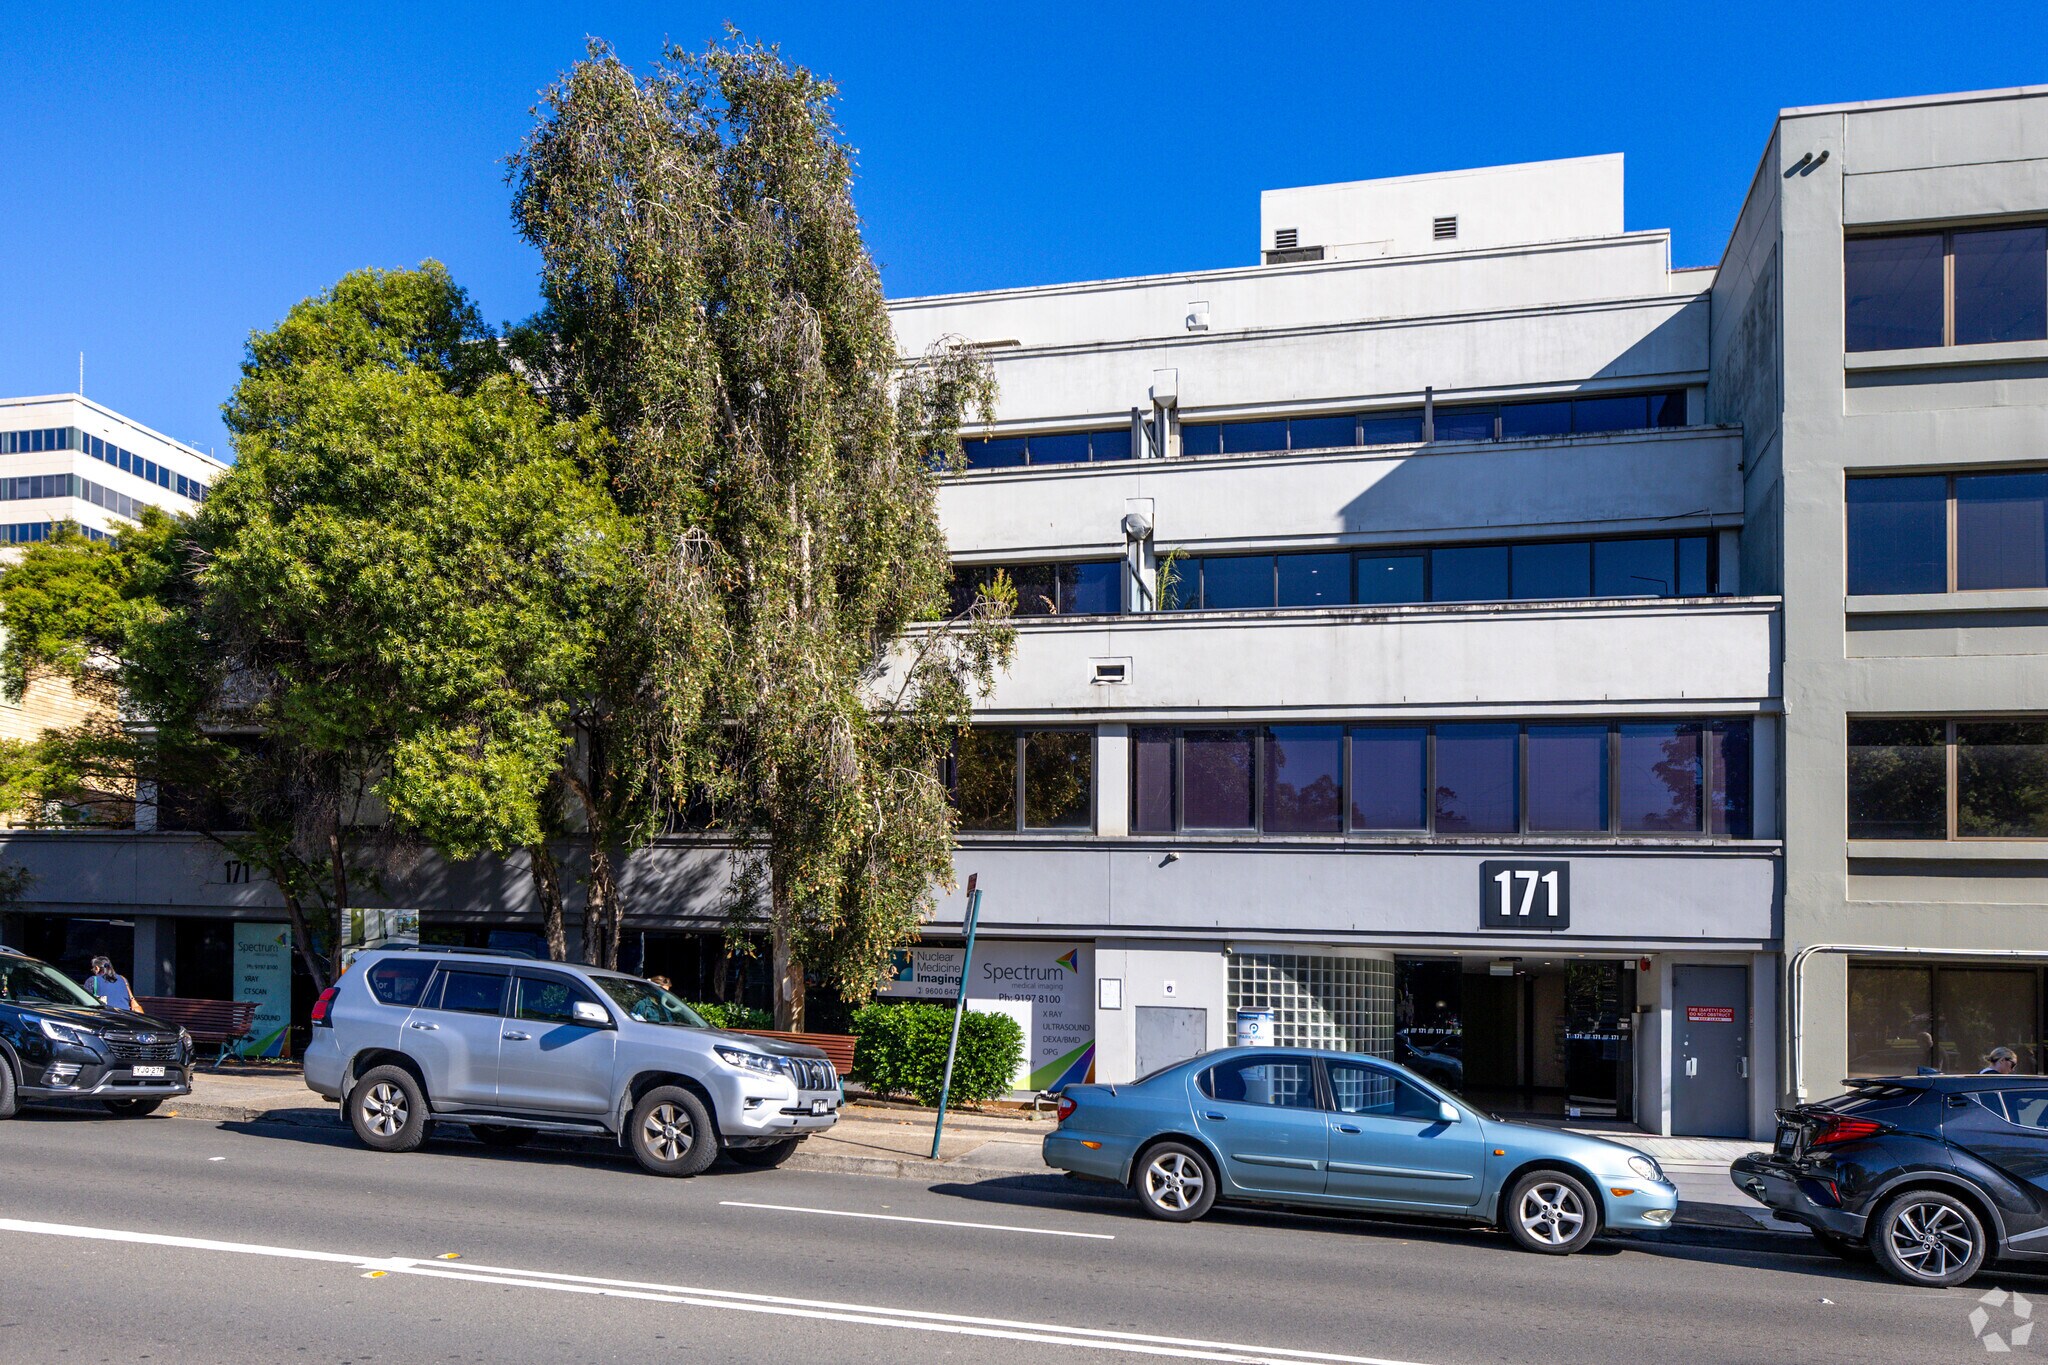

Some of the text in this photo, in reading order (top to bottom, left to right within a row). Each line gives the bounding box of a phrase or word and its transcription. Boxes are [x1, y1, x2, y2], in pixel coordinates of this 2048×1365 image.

[224, 861, 249, 883] 171
[1493, 870, 1558, 916] 171
[238, 942, 279, 953] Spectrum
[917, 952, 954, 961] Nuclear
[917, 962, 961, 973] Medicine
[983, 963, 1063, 983] Spectrum
[917, 973, 962, 985] Imaging
[1038, 983, 1063, 991] imaging
[999, 993, 1060, 1004] Ph: 9197 8100
